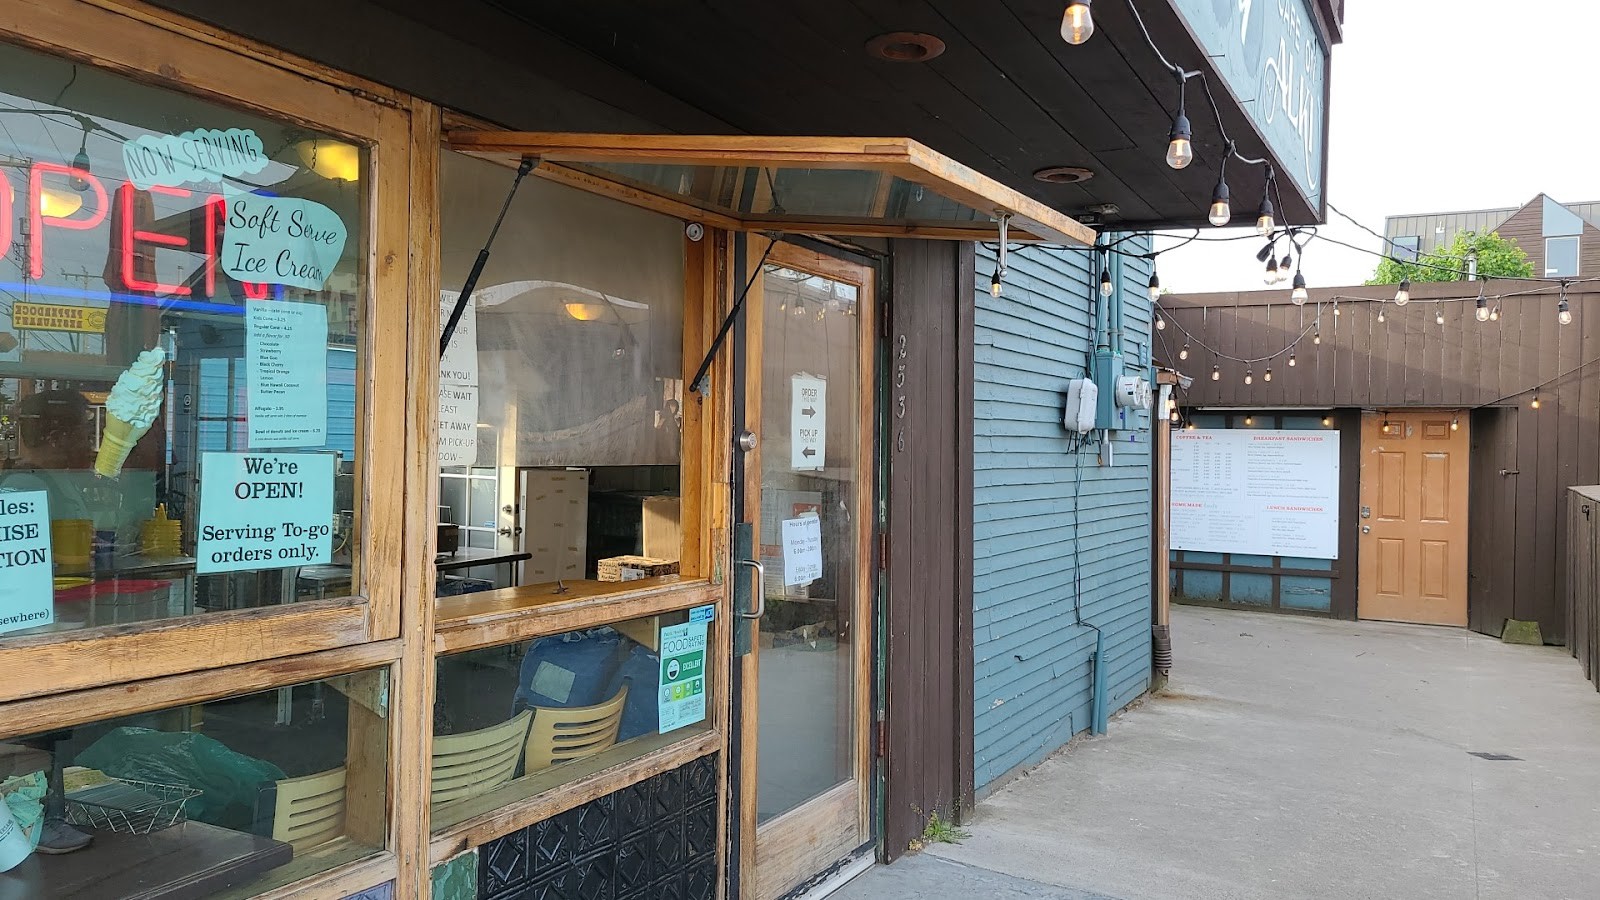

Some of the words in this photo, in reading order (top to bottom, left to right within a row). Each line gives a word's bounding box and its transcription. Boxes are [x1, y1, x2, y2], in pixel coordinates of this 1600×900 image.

[1278, 0, 1300, 52] CAFE
[125, 144, 175, 180] NOW
[182, 134, 257, 171] SERVING
[229, 200, 281, 239] Soft
[288, 209, 337, 245] Serve
[230, 242, 267, 274] Ice
[275, 249, 323, 281] Cream
[452, 371, 471, 380] YOU!
[453, 391, 472, 401] WAIT
[801, 388, 818, 397] ORDER
[450, 422, 471, 431] AWAY
[799, 428, 811, 437] PICK
[448, 437, 475, 448] PICK-UP
[234, 482, 303, 500] OPEN!
[202, 524, 276, 543] Serving
[282, 522, 329, 540] To-go
[211, 547, 272, 563] orders
[278, 543, 319, 561] only.
[663, 638, 688, 653] FOOD
[688, 634, 704, 642] SAFETY
[688, 640, 705, 649] RATING
[682, 659, 702, 671] EXCELLENT
